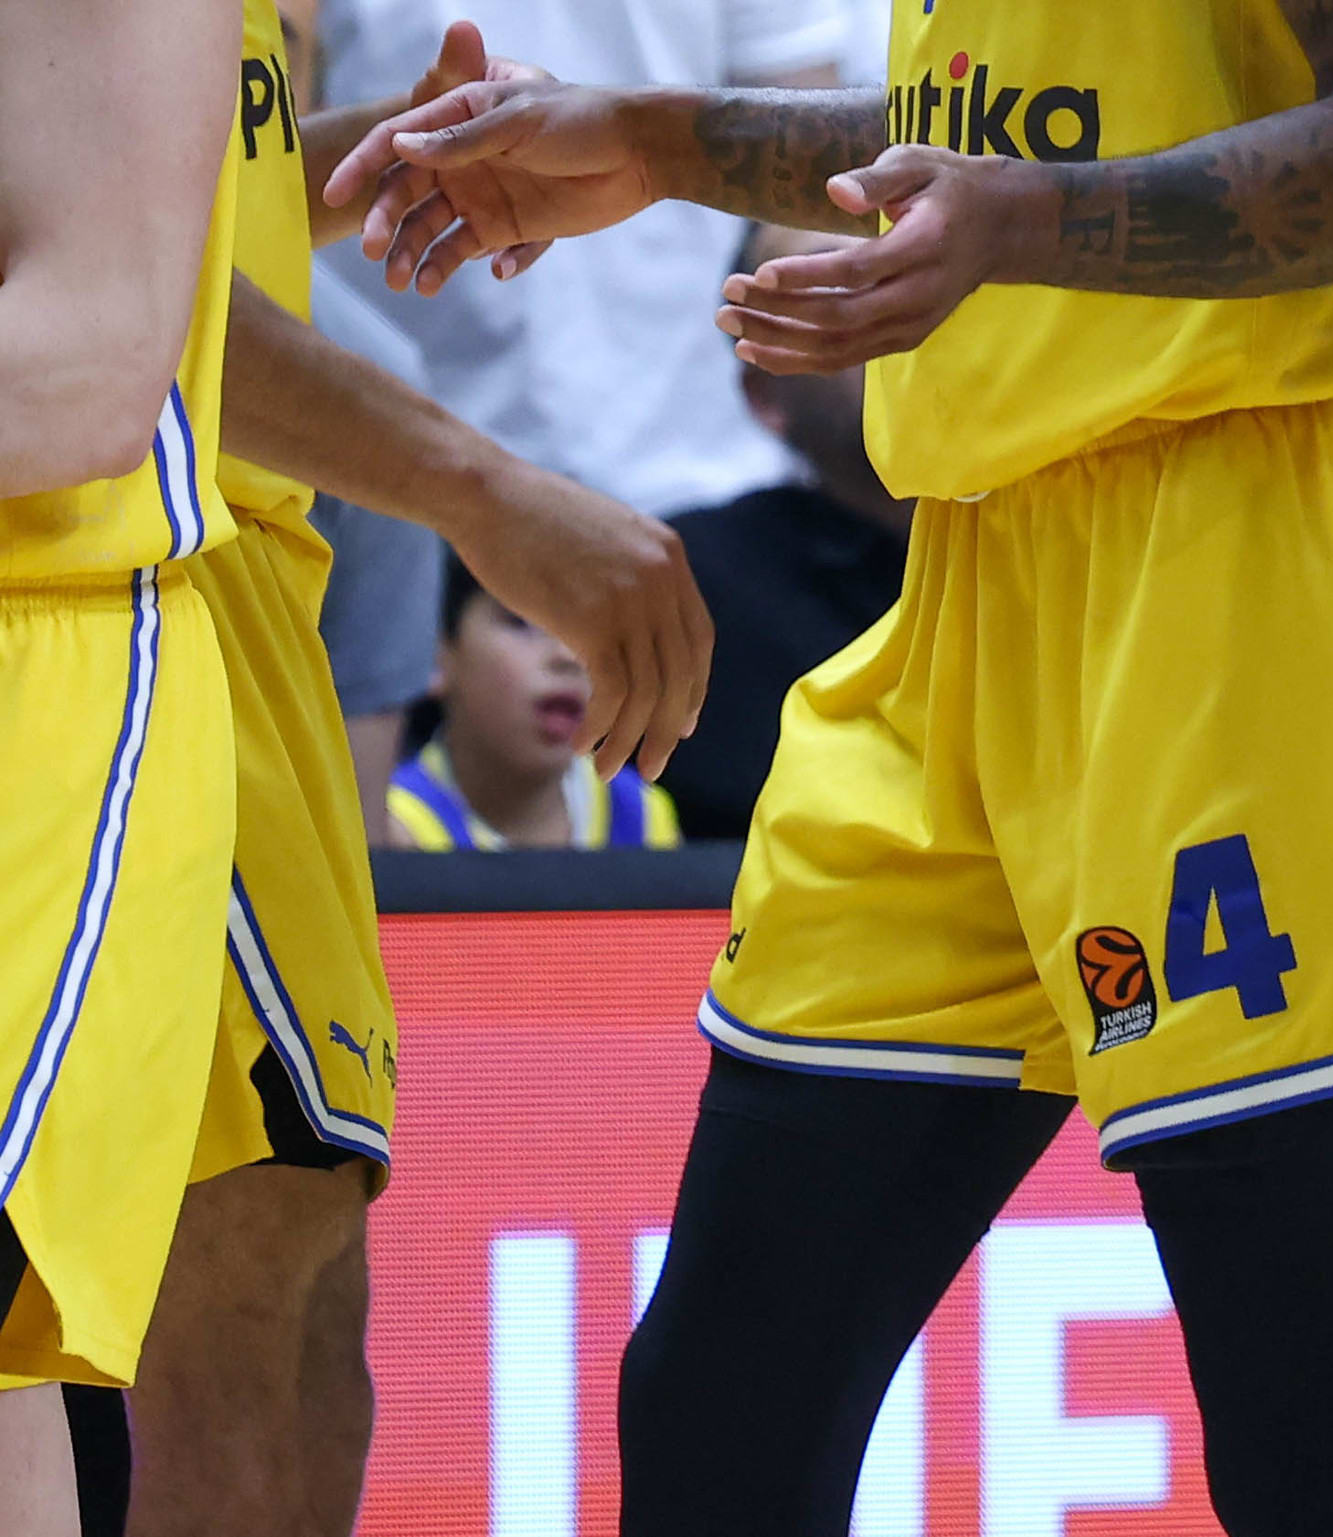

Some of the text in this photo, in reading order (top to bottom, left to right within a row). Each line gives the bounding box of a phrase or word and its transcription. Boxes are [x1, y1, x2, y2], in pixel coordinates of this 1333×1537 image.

[1163, 833, 1298, 1020] 4
[1098, 1015, 1153, 1042] AIRLINES
[1100, 1001, 1153, 1029] TURKISH
